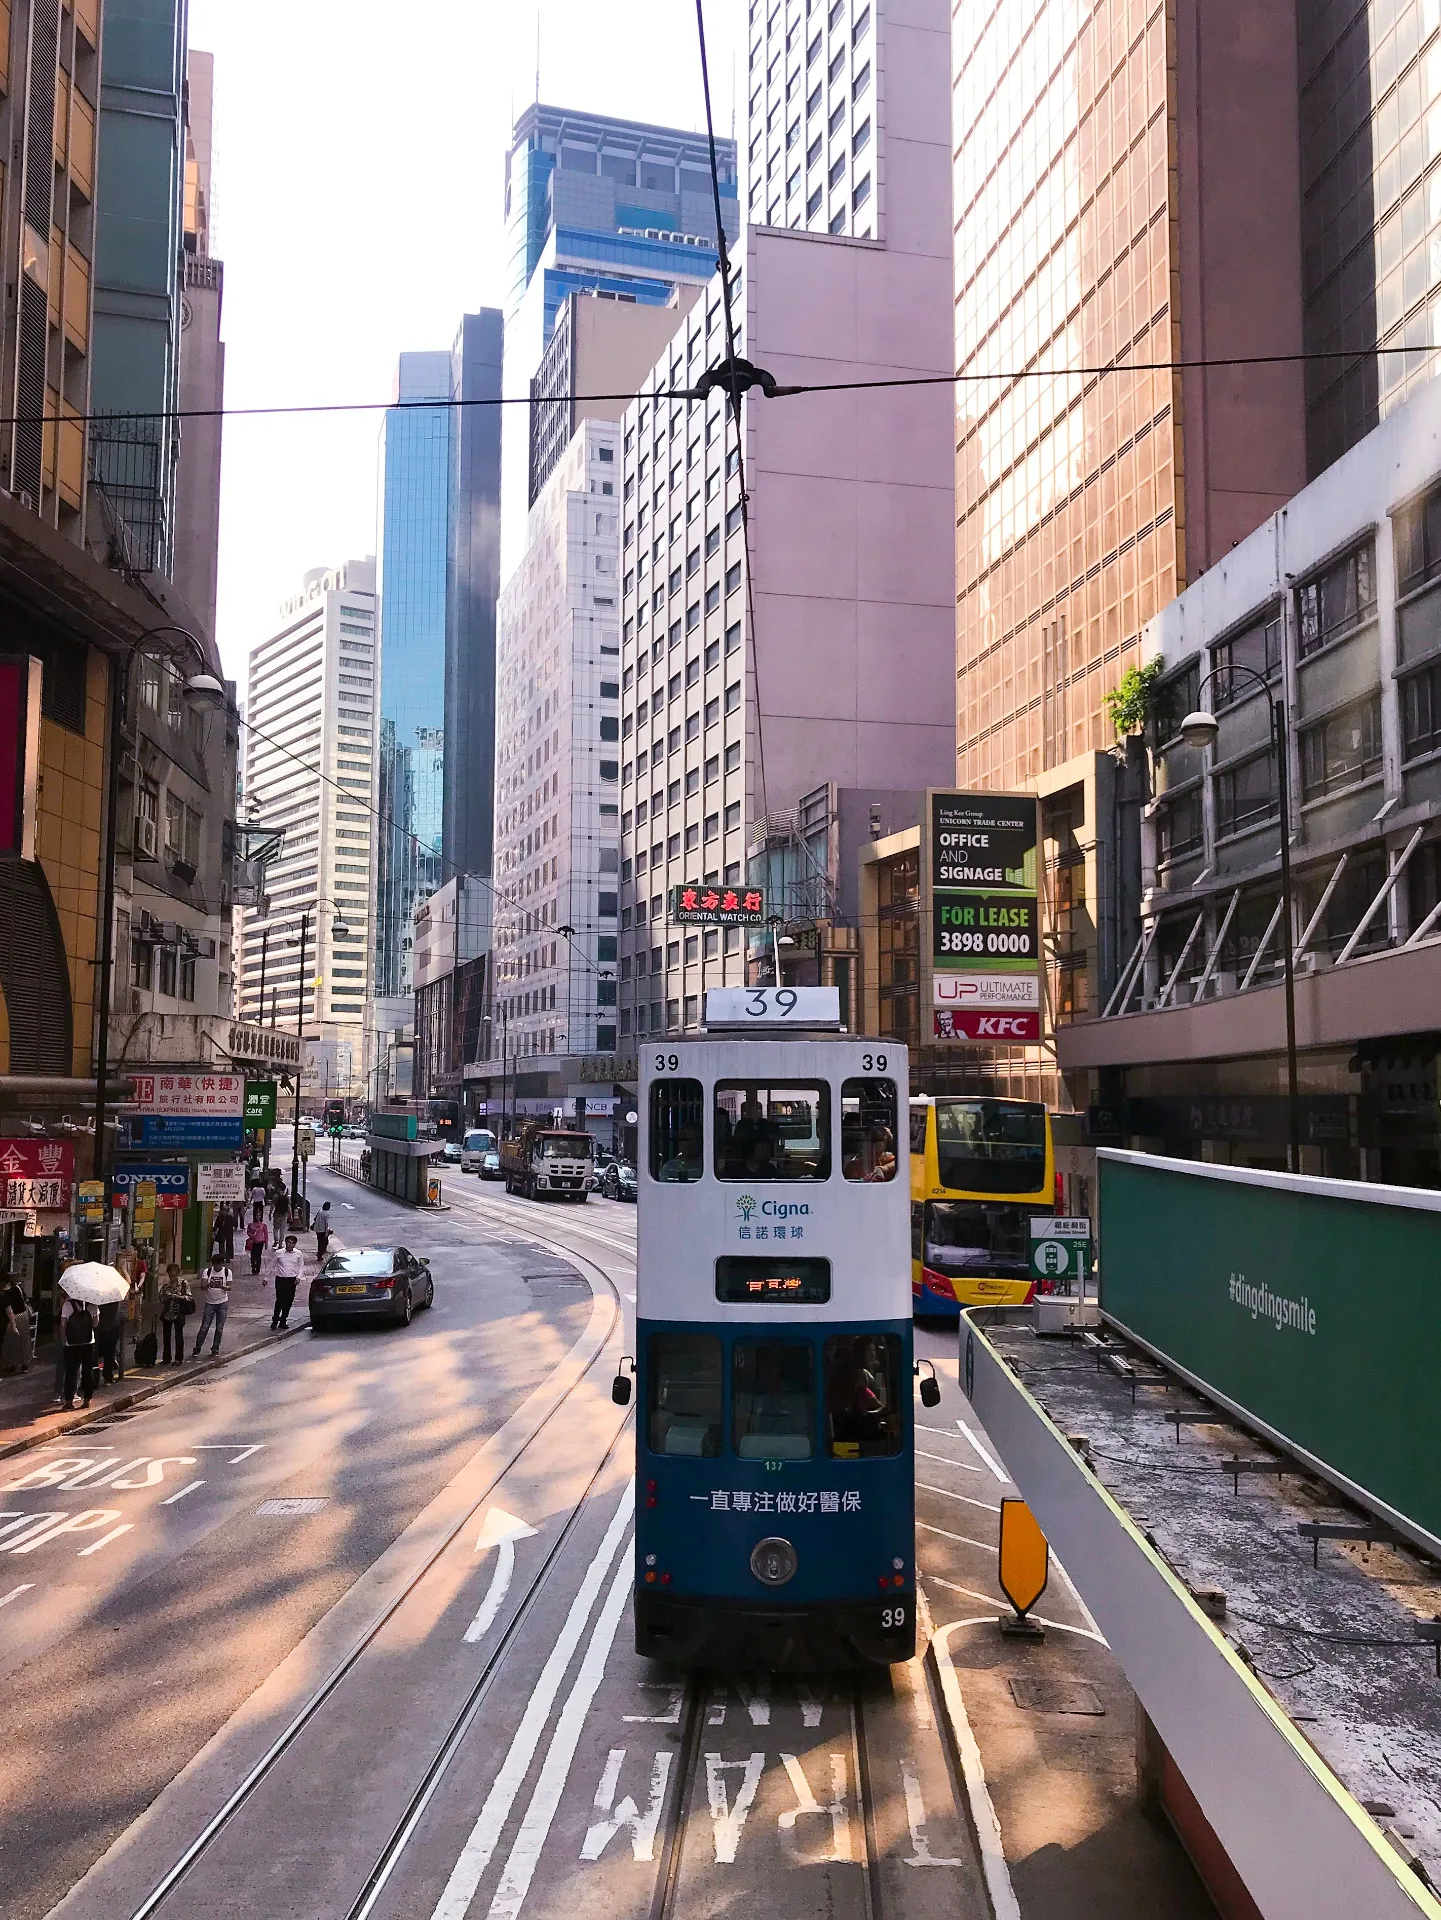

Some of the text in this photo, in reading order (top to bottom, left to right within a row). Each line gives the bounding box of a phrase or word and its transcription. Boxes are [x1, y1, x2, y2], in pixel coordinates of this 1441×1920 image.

[940, 809, 954, 817] Ling
[965, 810, 984, 819] Group
[940, 833, 989, 848] OFFICE
[940, 850, 969, 864] AND
[940, 866, 1003, 881] SIGNAGE
[679, 911, 718, 921] ORIENTAL
[720, 912, 749, 922] WATCH
[941, 905, 1029, 927] FOR LEASE
[941, 932, 1030, 953] 3898 0000
[938, 981, 1032, 999] UP ULTIMATE
[980, 992, 1032, 1001] PERFORMANCE
[745, 989, 798, 1016] 39
[976, 1017, 1029, 1035] KFC
[655, 1054, 679, 1071] 39
[862, 1054, 888, 1071] 39
[159, 1095, 239, 1105] 旅行社有限公司
[0, 1143, 64, 1176] 金豐
[115, 1173, 185, 1186] ONKYO
[761, 1200, 809, 1219] Cigna
[738, 1226, 804, 1239] 信諾環球
[1229, 1272, 1316, 1335] #dingdingsmile
[0, 1456, 198, 1492] BUS
[764, 1461, 783, 1471] 137
[689, 1489, 862, 1513] 一直專注做好醫保
[881, 1607, 905, 1628] 39
[578, 1748, 963, 1867] TRAM
